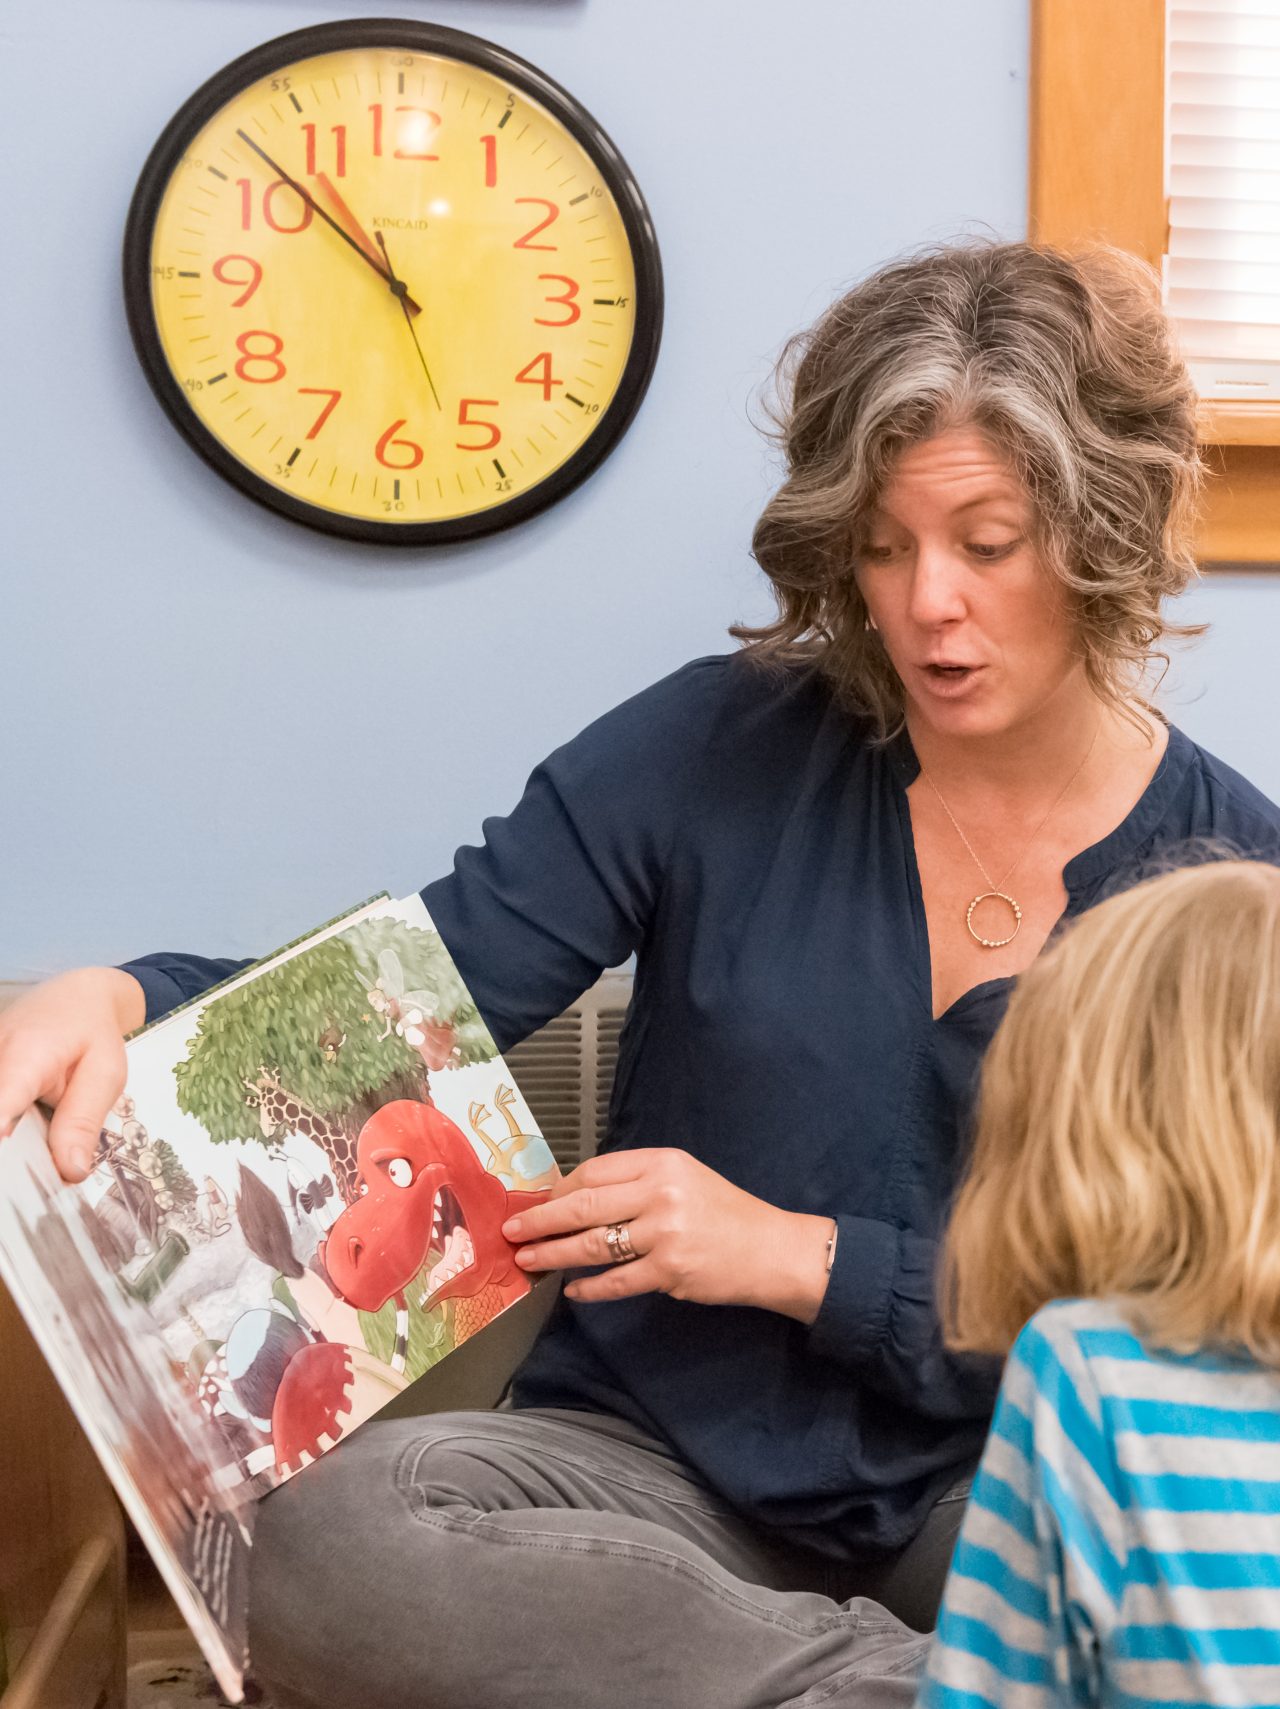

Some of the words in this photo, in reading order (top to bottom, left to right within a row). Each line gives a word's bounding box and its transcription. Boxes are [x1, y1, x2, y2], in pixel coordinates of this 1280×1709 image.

[271, 77, 292, 91] 55
[507, 94, 516, 108] 5
[301, 123, 346, 177] 11
[368, 103, 442, 161] 12
[479, 134, 497, 188] 1
[236, 178, 314, 234] 10
[372, 217, 429, 231] KINCAID
[513, 197, 560, 252] 2
[212, 254, 263, 308] 9
[534, 273, 581, 327] 3
[615, 297, 629, 309] 15
[234, 330, 287, 384] 8
[514, 352, 564, 401] 4
[297, 387, 342, 440] 7
[456, 398, 501, 451] 5
[375, 419, 424, 470] 6
[274, 464, 292, 479] 35
[495, 479, 513, 492] 25
[382, 501, 406, 513] 30
